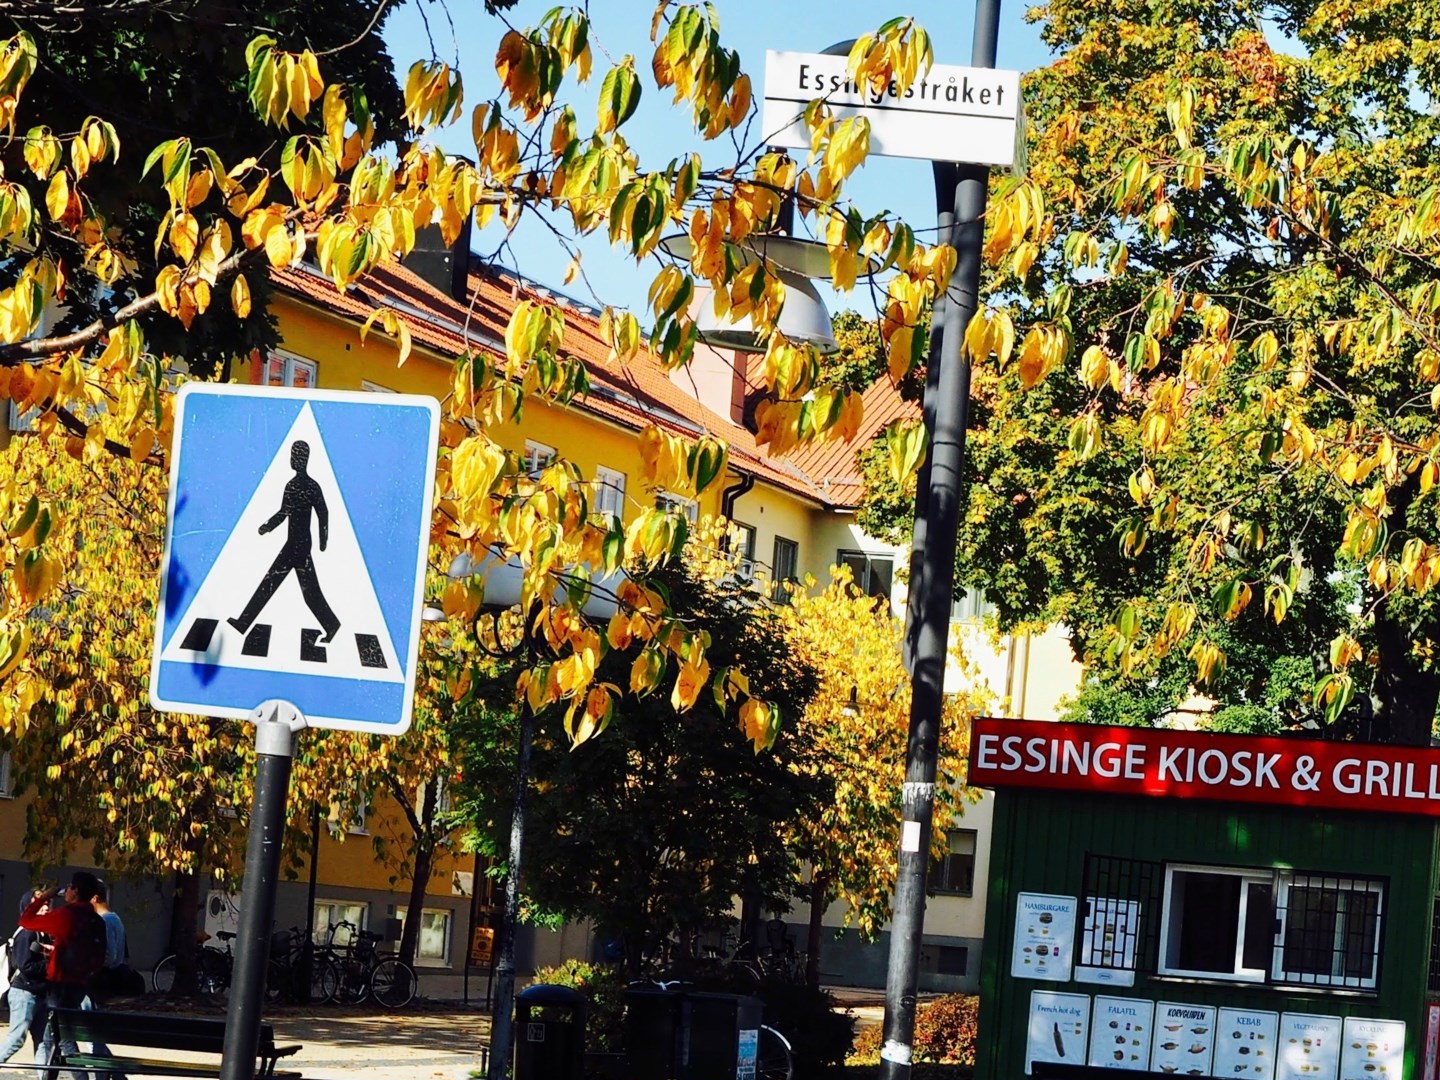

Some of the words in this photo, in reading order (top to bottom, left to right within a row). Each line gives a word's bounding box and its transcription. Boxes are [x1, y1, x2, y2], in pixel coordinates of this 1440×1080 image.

[799, 64, 1004, 106] Essigestråket
[977, 734, 1147, 779] ESSINGE
[1157, 746, 1282, 789] KIOSK
[1291, 755, 1322, 791] &
[1025, 902, 1070, 913] HAMBURGARE
[1037, 1004, 1058, 1014] French
[1059, 1006, 1069, 1015] hot
[1069, 1007, 1081, 1017] dog
[1108, 1006, 1137, 1016] FALAFEL
[1167, 1008, 1206, 1020] KORVGUIDEN
[1236, 1017, 1261, 1027] KEBAB
